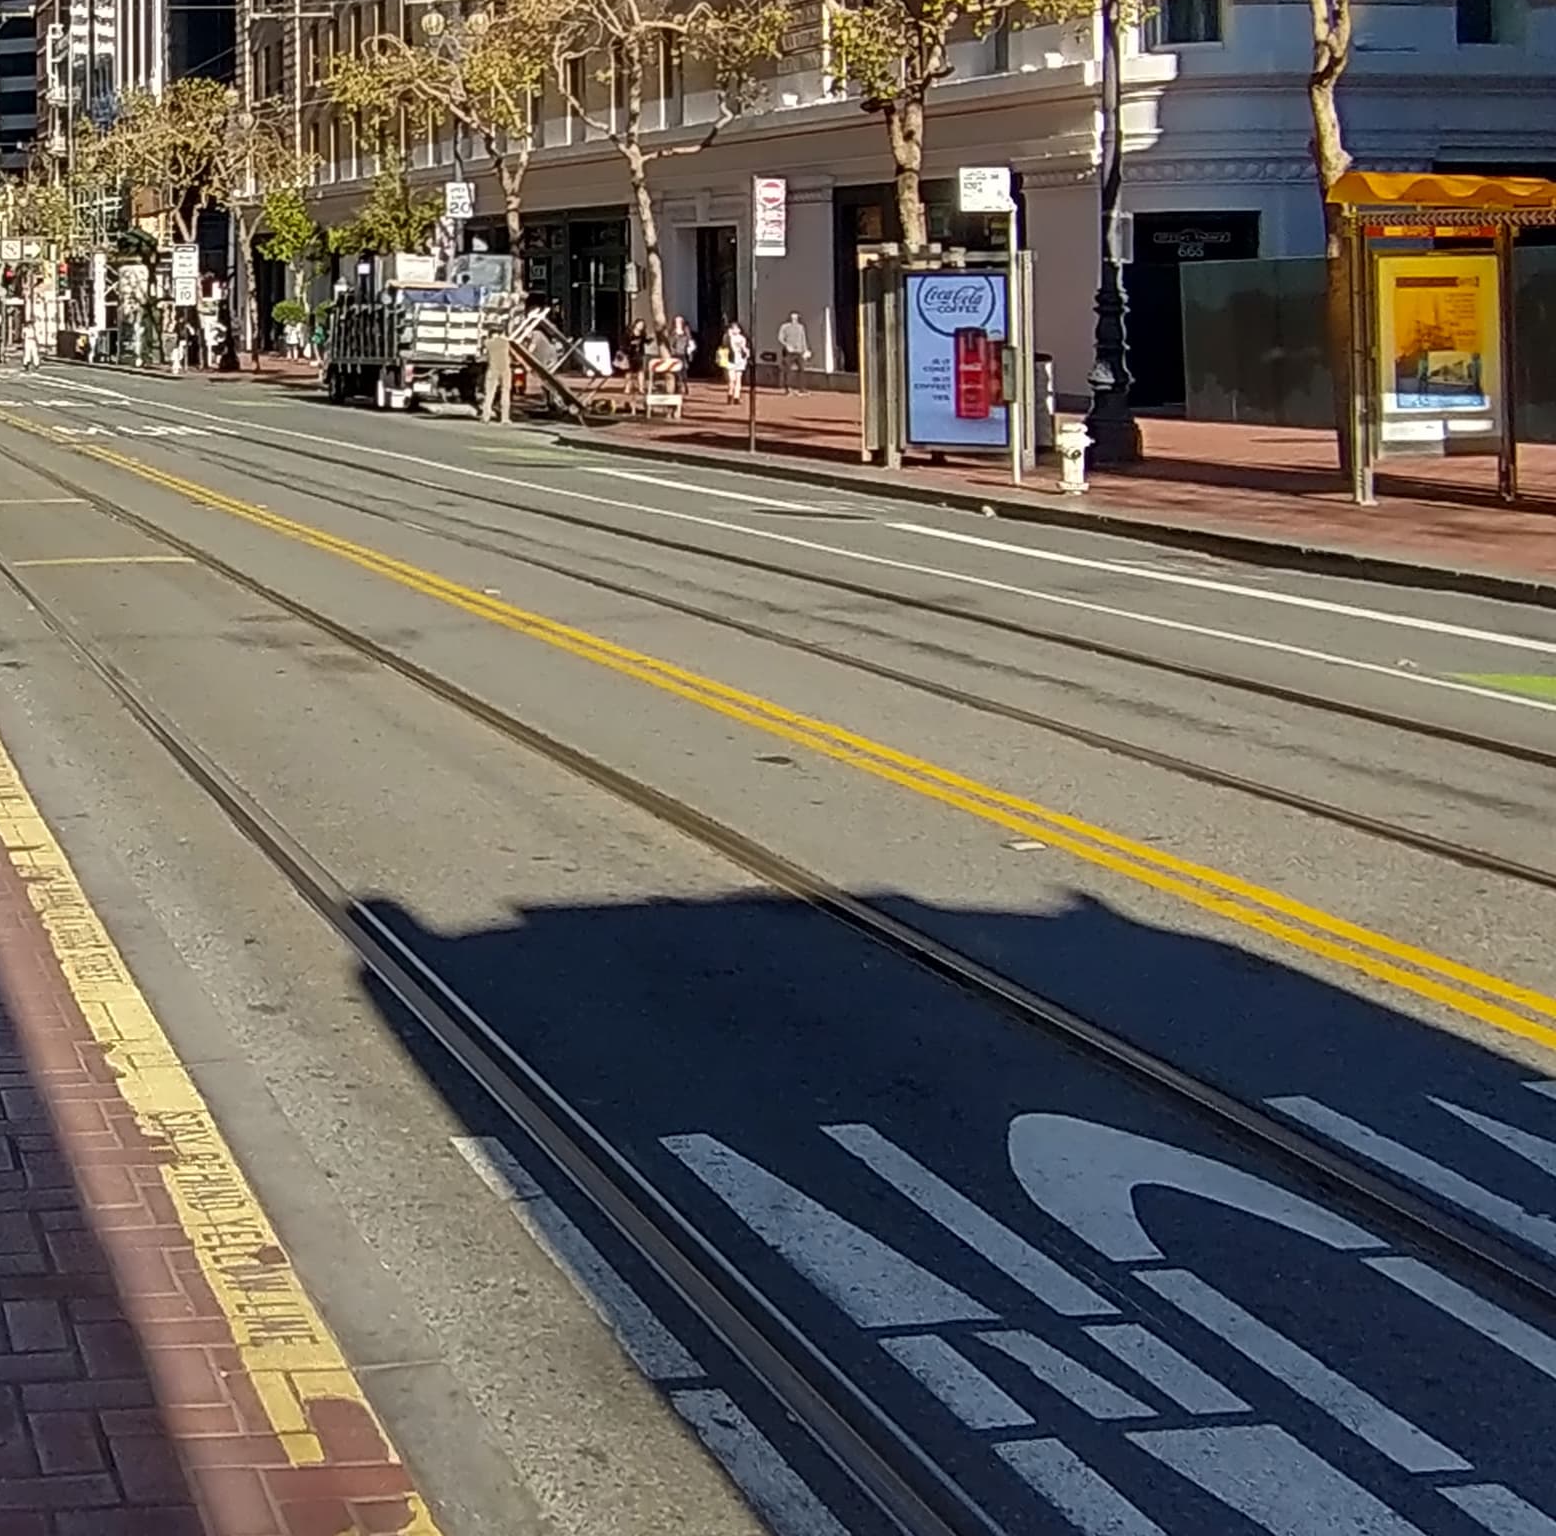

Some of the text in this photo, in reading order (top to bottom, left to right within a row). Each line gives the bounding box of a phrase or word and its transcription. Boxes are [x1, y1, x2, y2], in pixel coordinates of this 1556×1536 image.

[449, 201, 470, 214] 20
[938, 305, 980, 314] COFFEE
[147, 1112, 320, 1347] STAY BEHIND YELLOW LINE
